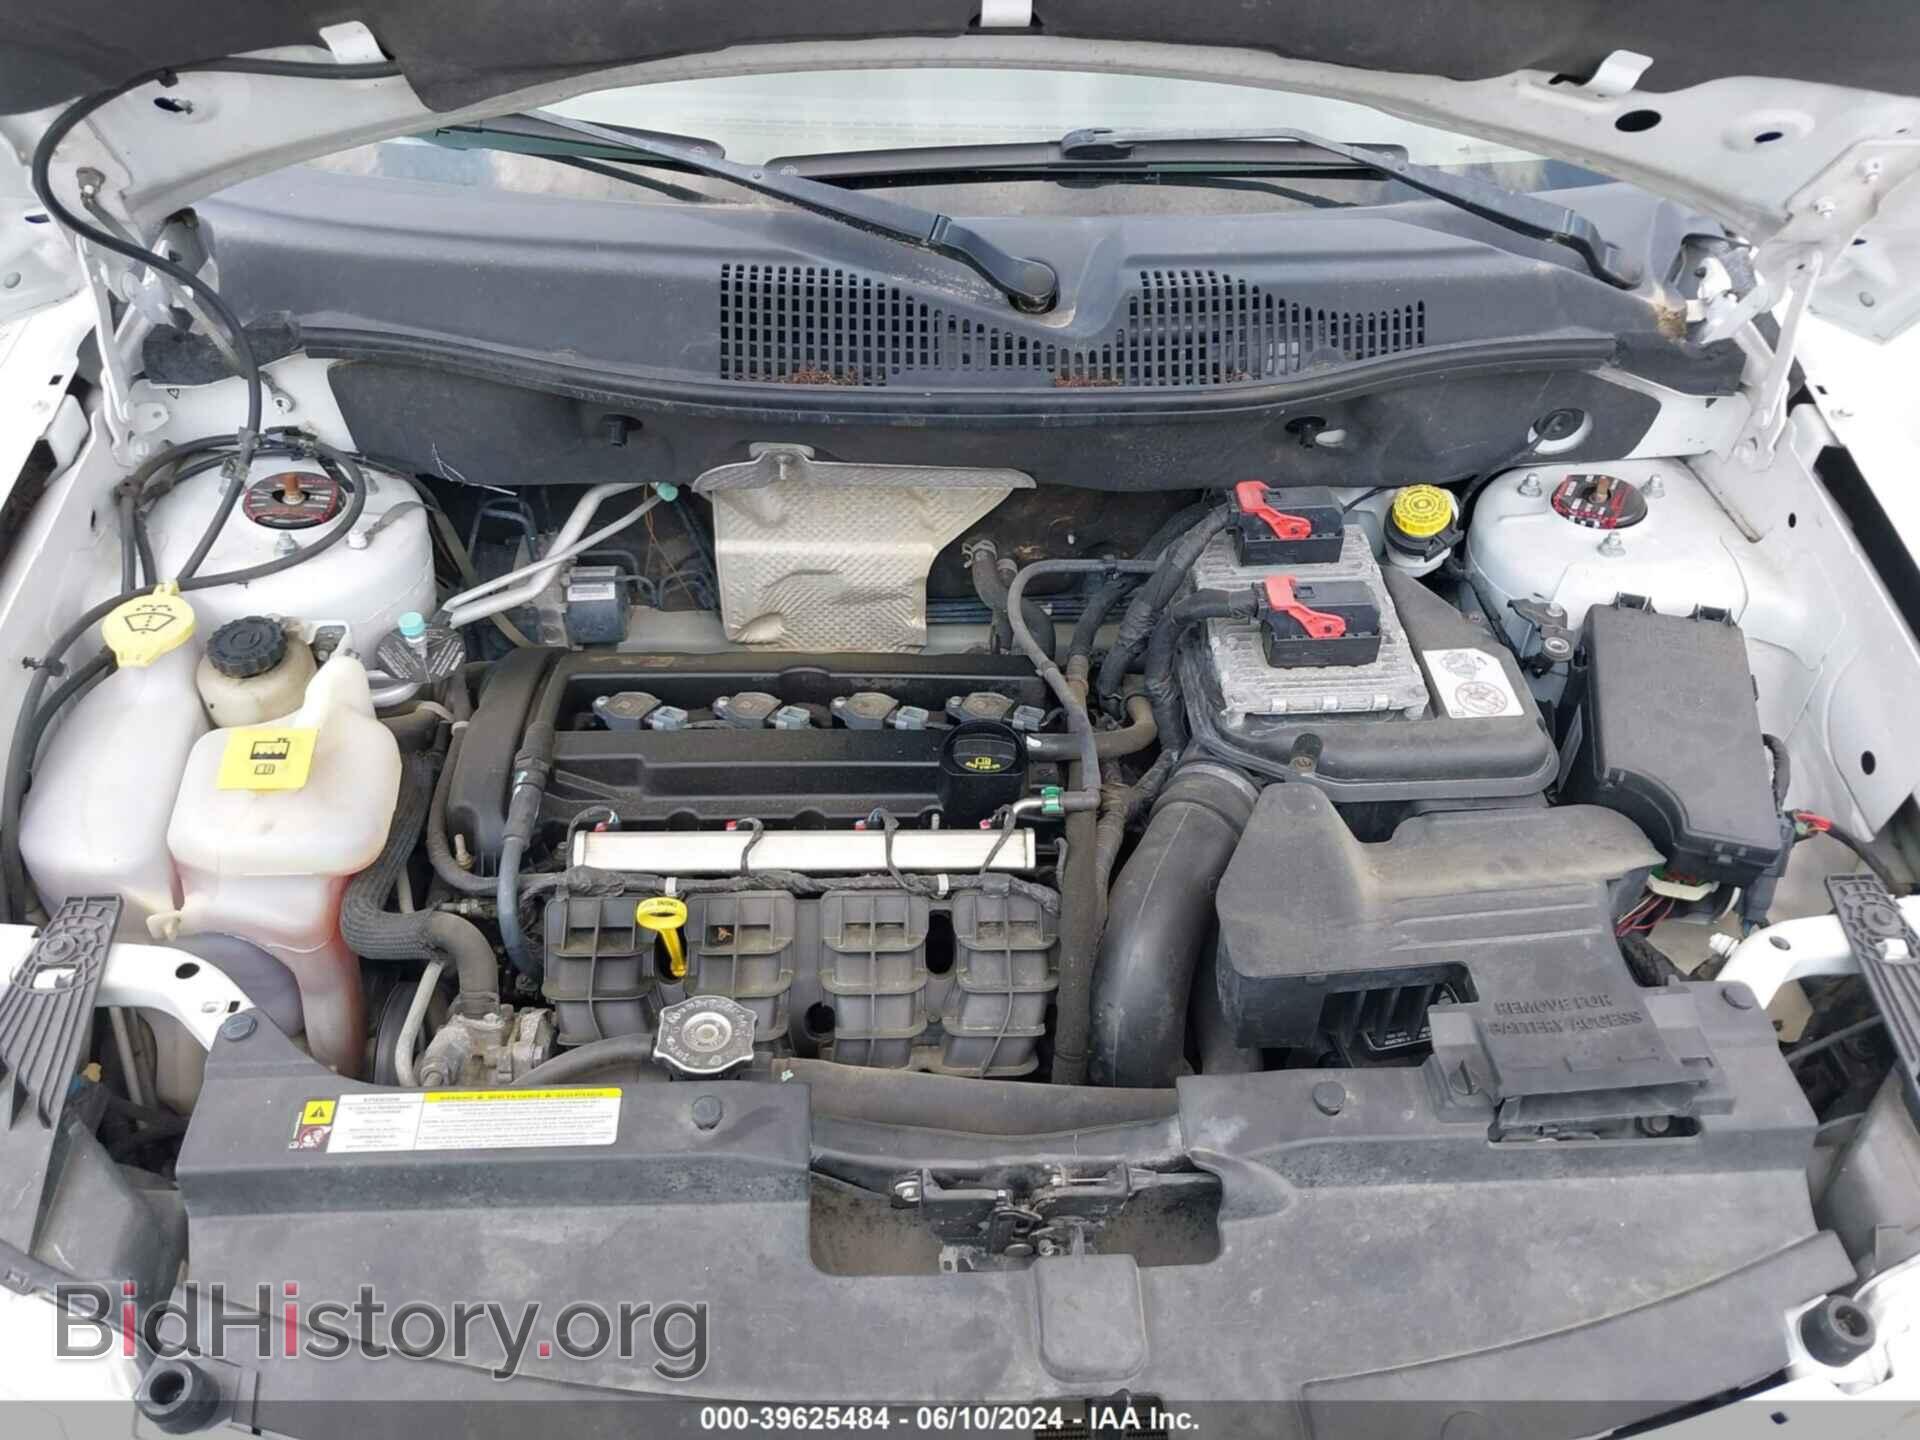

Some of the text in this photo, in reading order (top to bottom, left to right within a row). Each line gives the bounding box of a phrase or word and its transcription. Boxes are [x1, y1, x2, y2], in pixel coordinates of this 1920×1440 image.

[1494, 994, 1614, 1015] REMOVE FOR
[1488, 1011, 1643, 1036] BATTERY ACCESS
